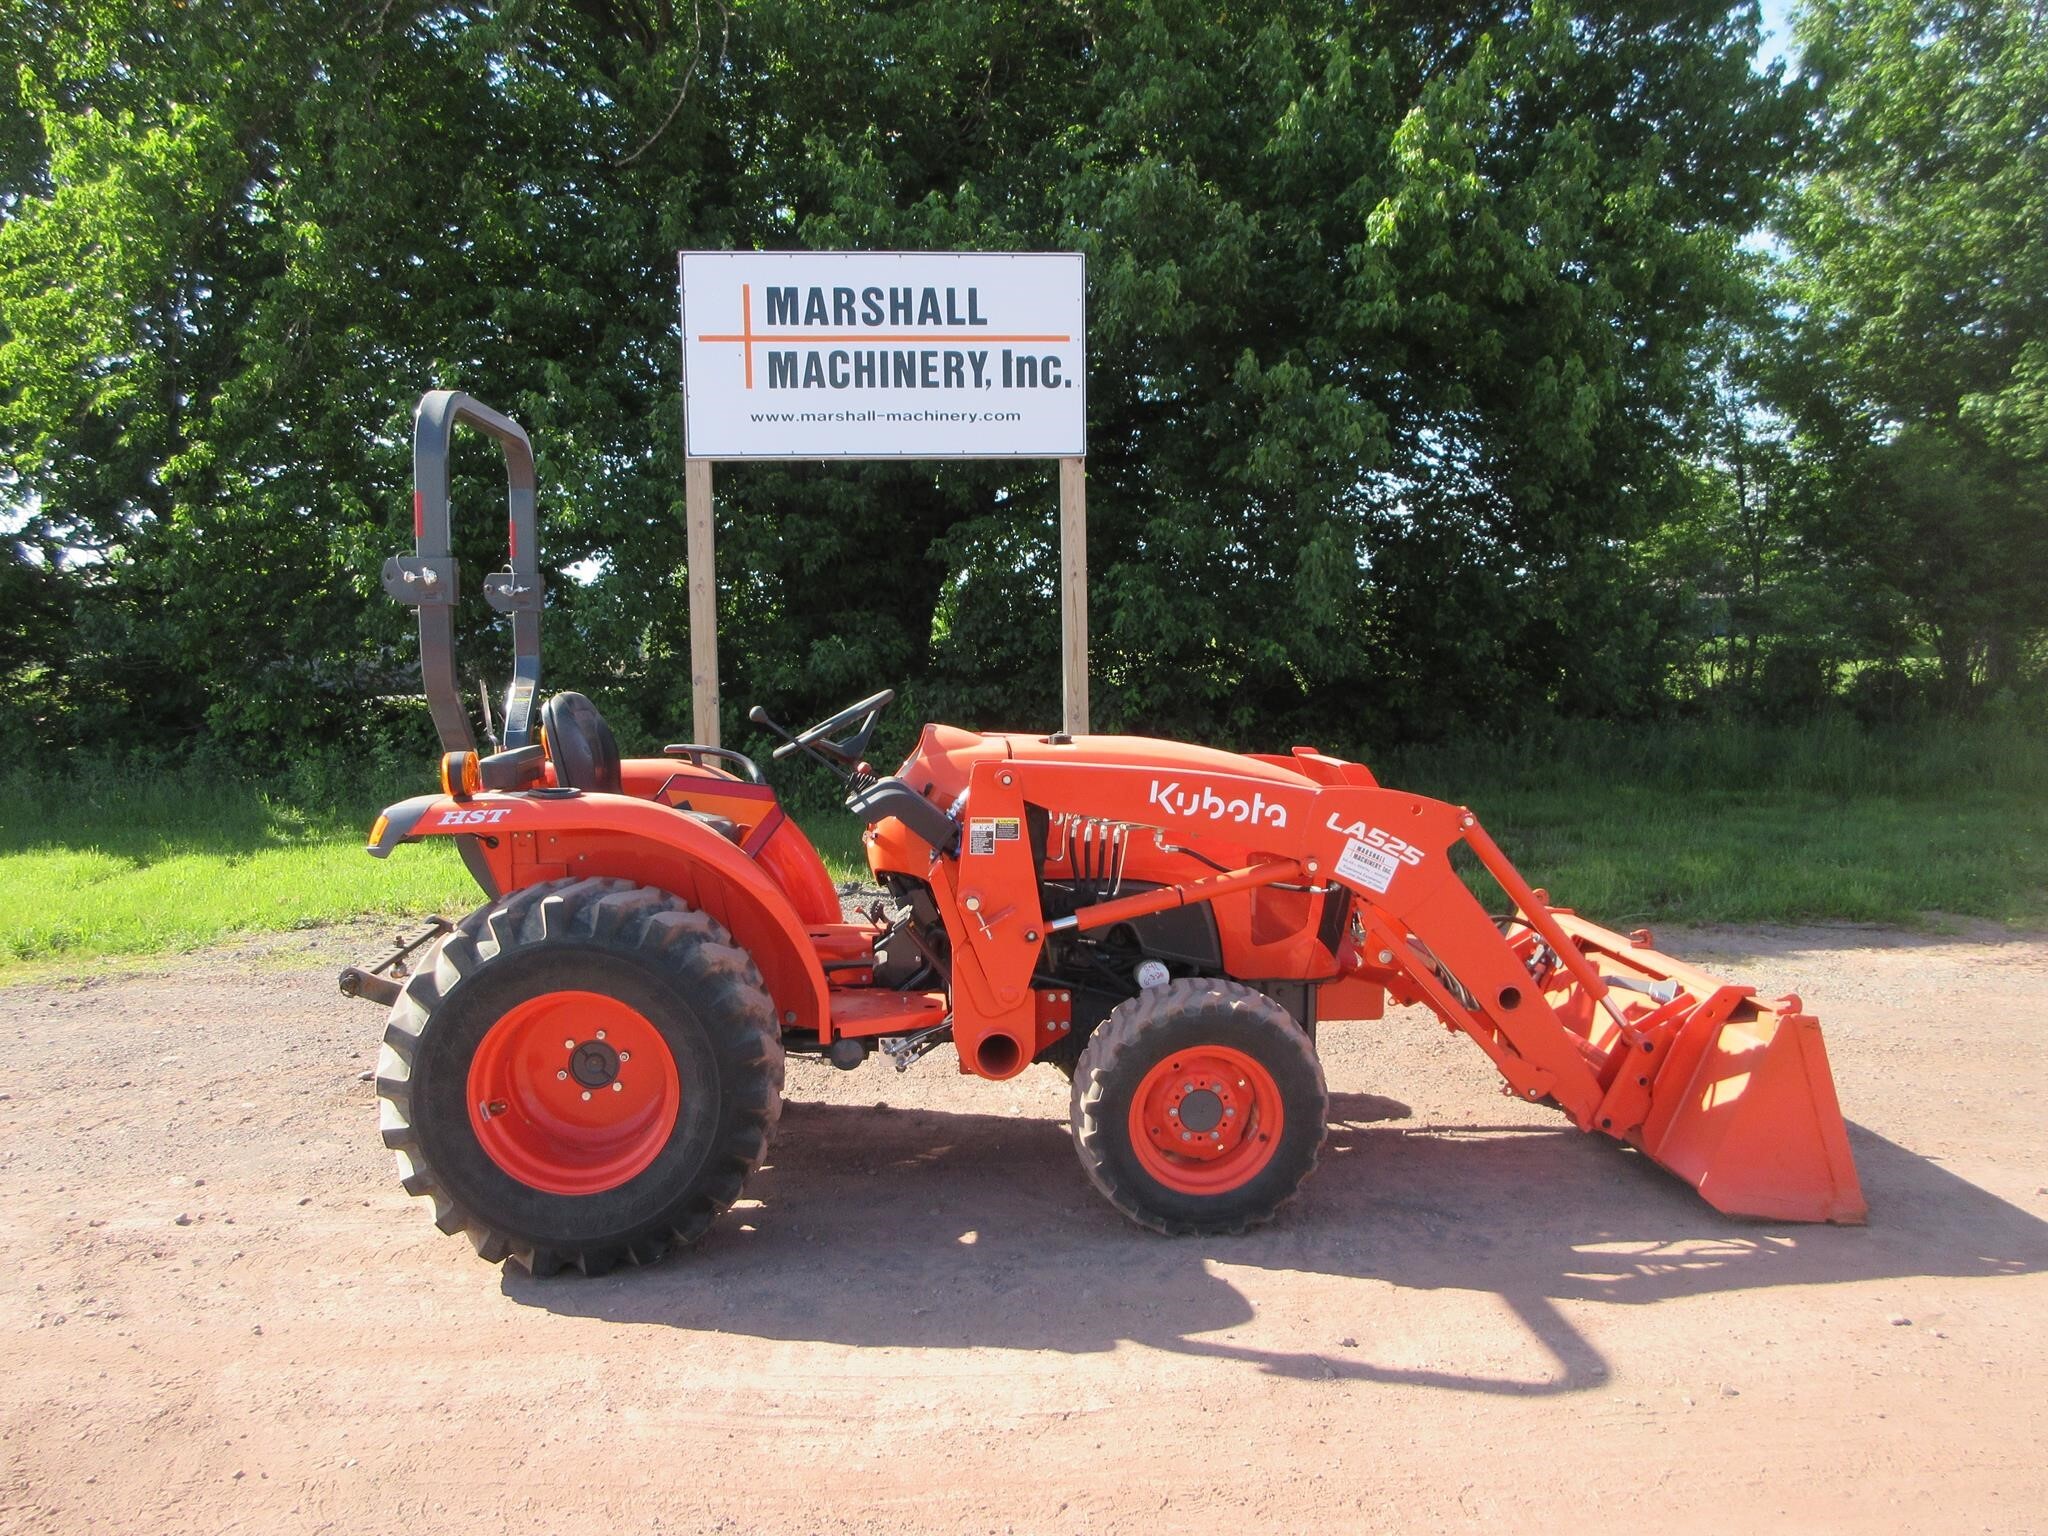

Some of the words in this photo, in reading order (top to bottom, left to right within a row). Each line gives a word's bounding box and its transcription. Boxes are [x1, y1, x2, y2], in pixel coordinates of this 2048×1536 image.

[766, 286, 988, 327] MARSHALL
[768, 349, 992, 391] MACHINERY,
[1002, 349, 1072, 389] Inc.
[750, 410, 1021, 423] www.marshall-machinery.com
[437, 808, 512, 826] HST
[1149, 780, 1287, 827] Kubota
[1326, 812, 1425, 866] LA525
